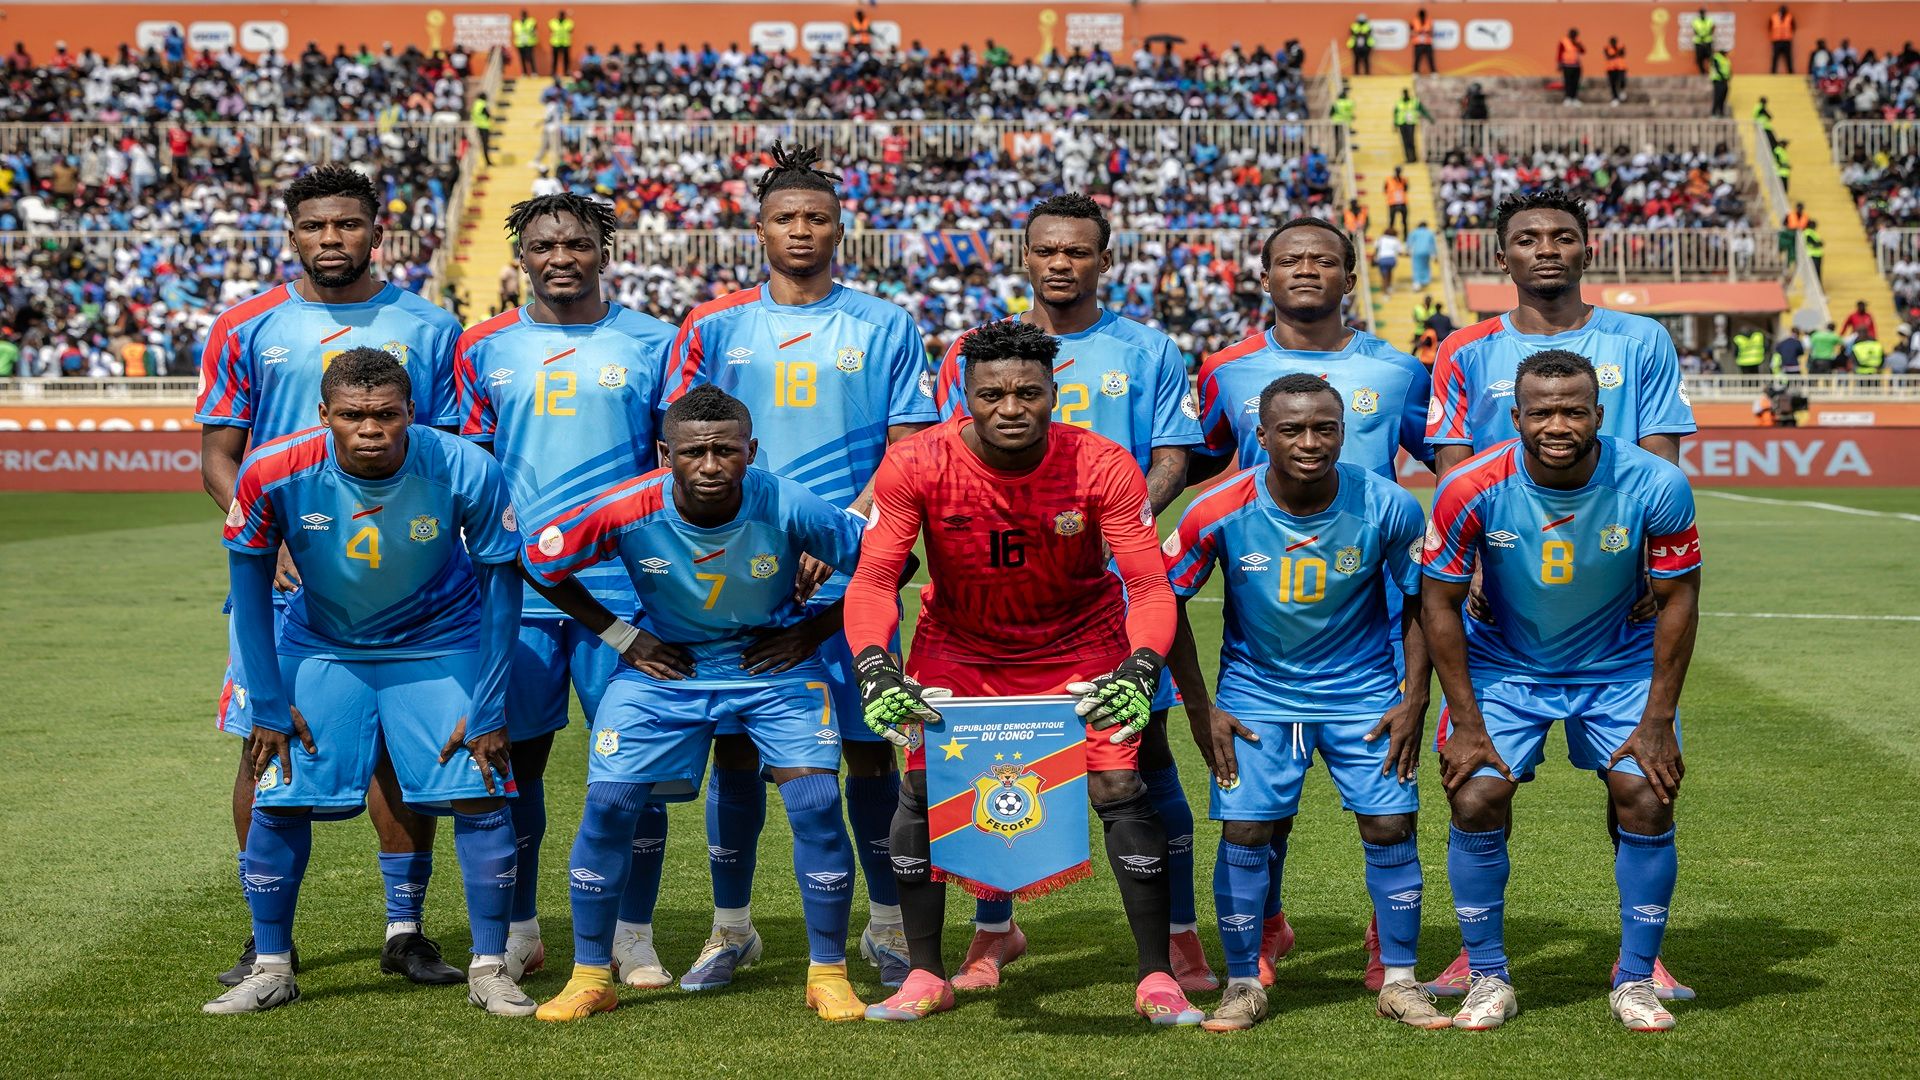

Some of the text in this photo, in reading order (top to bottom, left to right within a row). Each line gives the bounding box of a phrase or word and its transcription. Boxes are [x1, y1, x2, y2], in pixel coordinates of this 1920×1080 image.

[263, 357, 287, 365] umbro
[492, 379, 512, 387] umbro
[534, 370, 577, 416] 12
[774, 360, 817, 408] 18
[1053, 383, 1092, 429] 2
[0, 449, 201, 472] RICAN NATIO
[1679, 440, 1873, 476] KENYA
[346, 526, 381, 569] 4
[990, 529, 1025, 568] 16
[1488, 541, 1515, 549] umbro
[642, 567, 668, 575] umbro
[1541, 541, 1574, 584] 8
[695, 572, 726, 609] 7
[1279, 557, 1326, 603] 10
[805, 682, 830, 725] 7
[953, 721, 1065, 732] REPUBLIQUE DEMOCRATIQUE
[981, 730, 1035, 741] DU CONGO
[986, 816, 1033, 831] FECOFA
[1124, 865, 1162, 874] umbro
[808, 883, 848, 892] umbro
[1633, 915, 1665, 923] umbro
